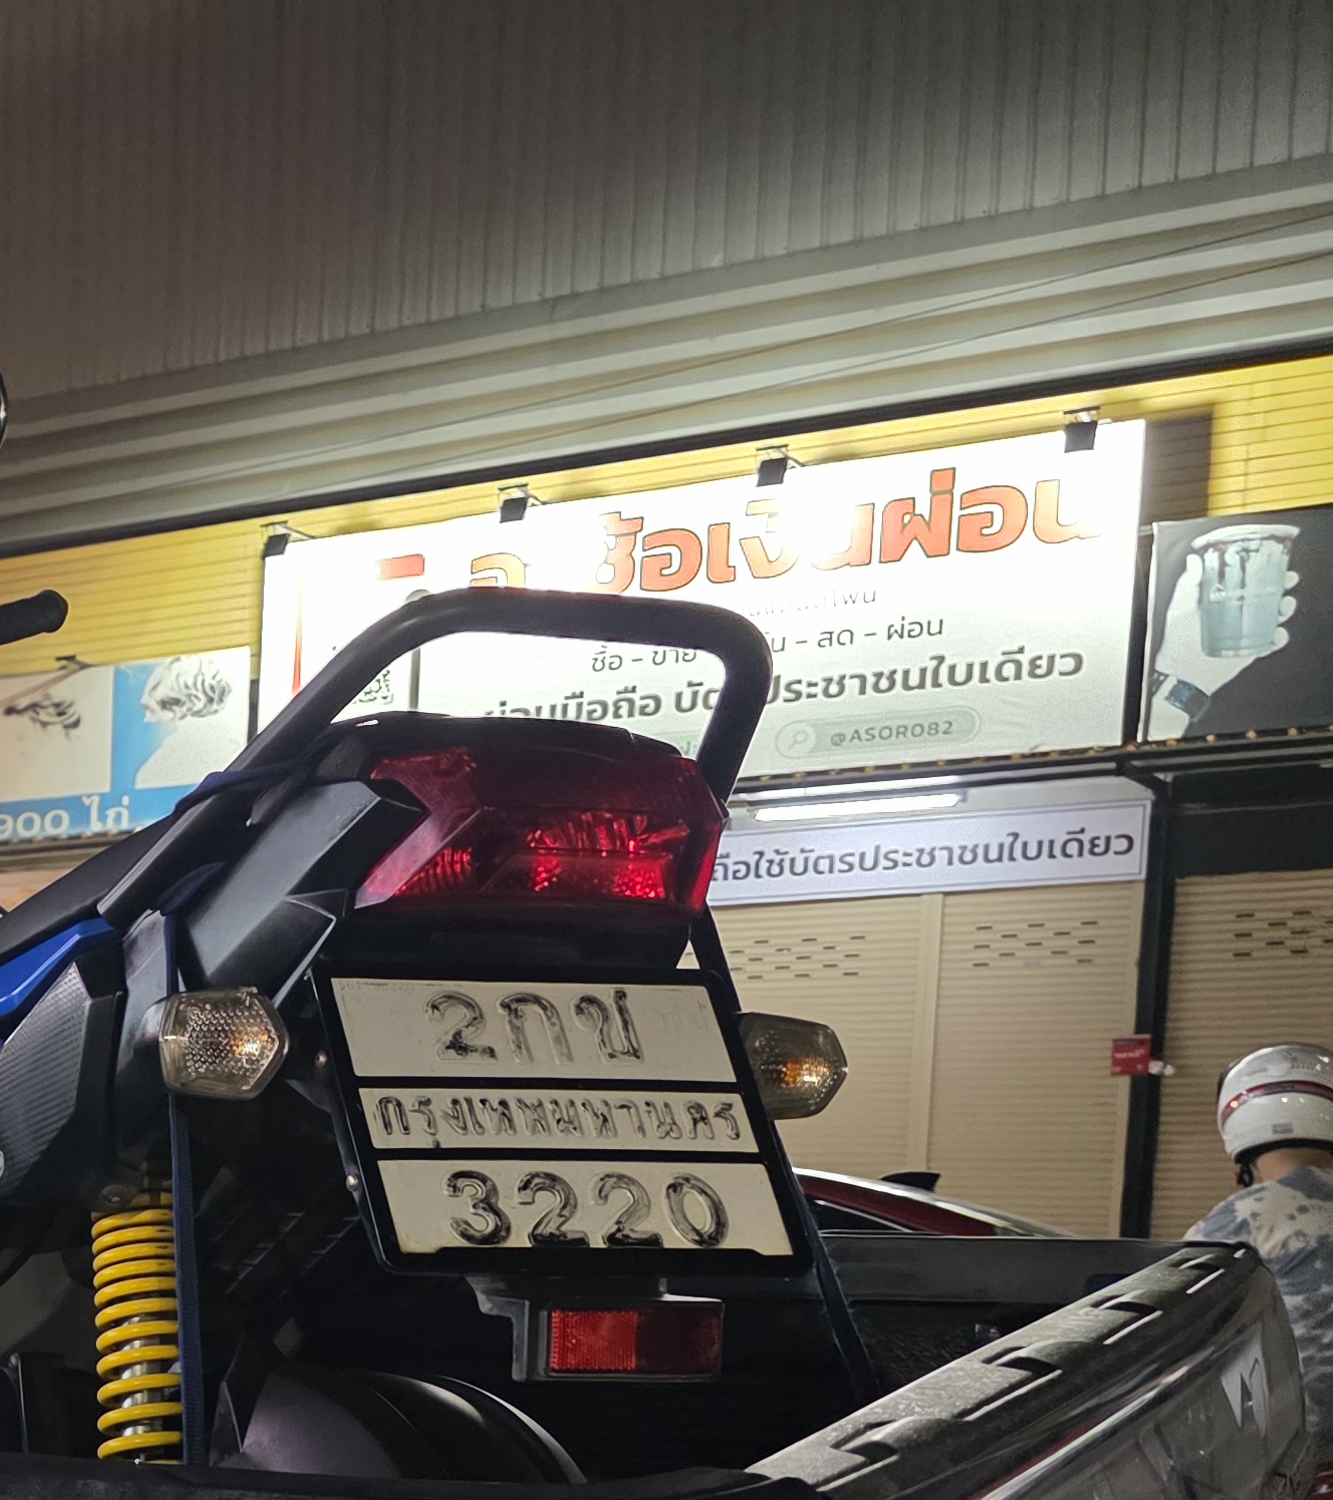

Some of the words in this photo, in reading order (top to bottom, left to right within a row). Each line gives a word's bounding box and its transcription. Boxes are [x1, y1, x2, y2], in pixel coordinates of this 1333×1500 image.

[886, 615, 945, 642] ผ่อน
[424, 987, 644, 1065] 2กข
[375, 1095, 742, 1148] กรุงเทพมหานคร
[443, 1169, 731, 1249] 3220
